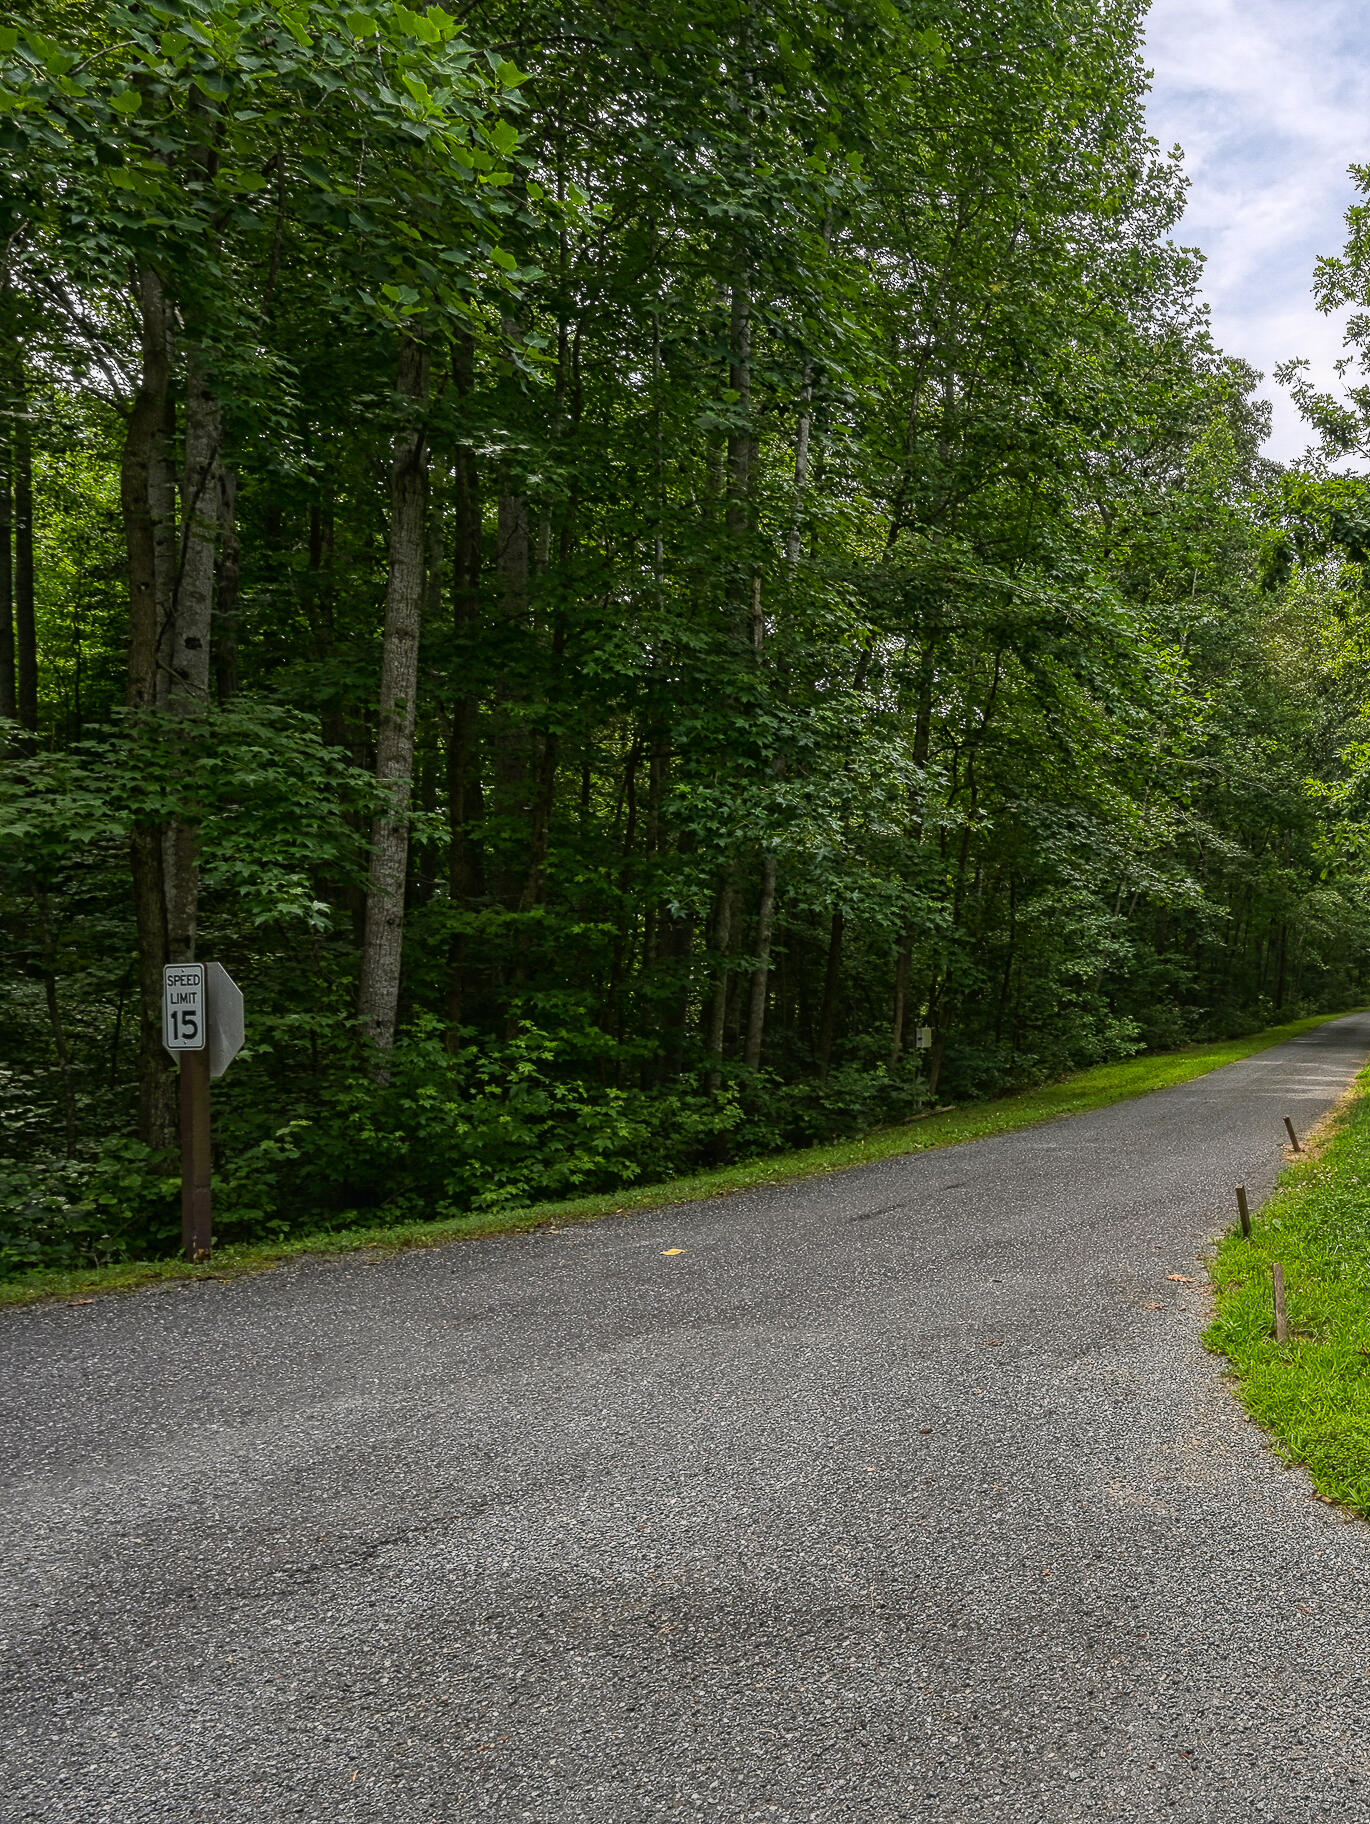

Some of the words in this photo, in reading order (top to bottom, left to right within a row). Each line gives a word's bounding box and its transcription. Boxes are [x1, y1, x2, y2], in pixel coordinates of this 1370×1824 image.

[167, 974, 200, 987] SPEED
[170, 992, 197, 1004] LIMIT
[171, 1010, 198, 1040] 15
